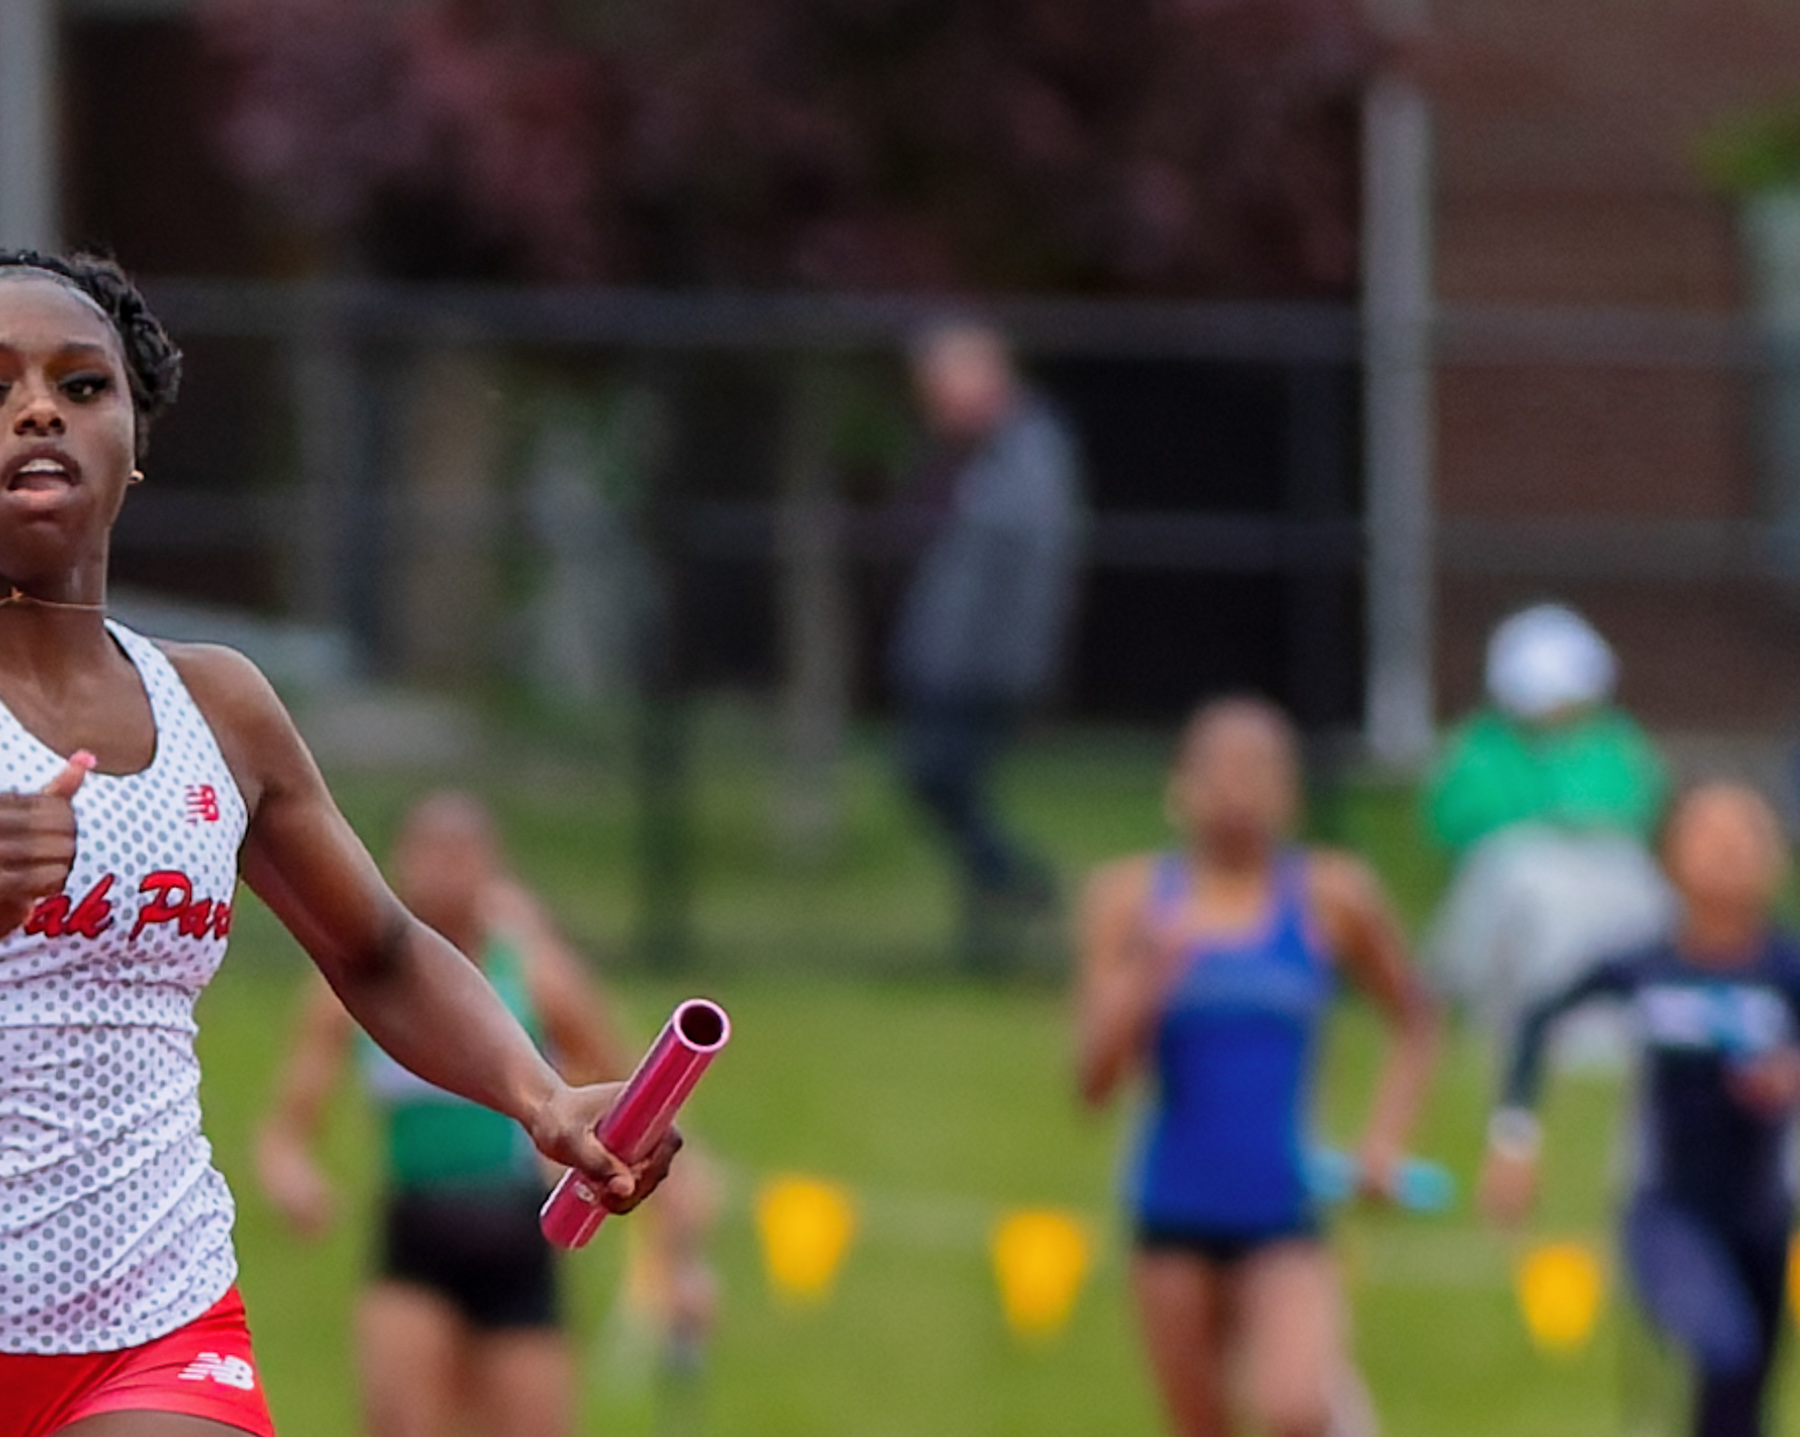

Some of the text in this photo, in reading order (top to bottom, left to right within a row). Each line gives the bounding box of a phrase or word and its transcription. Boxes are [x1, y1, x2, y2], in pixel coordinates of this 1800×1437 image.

[25, 870, 231, 942] ak Par
[177, 1352, 254, 1391] NB
